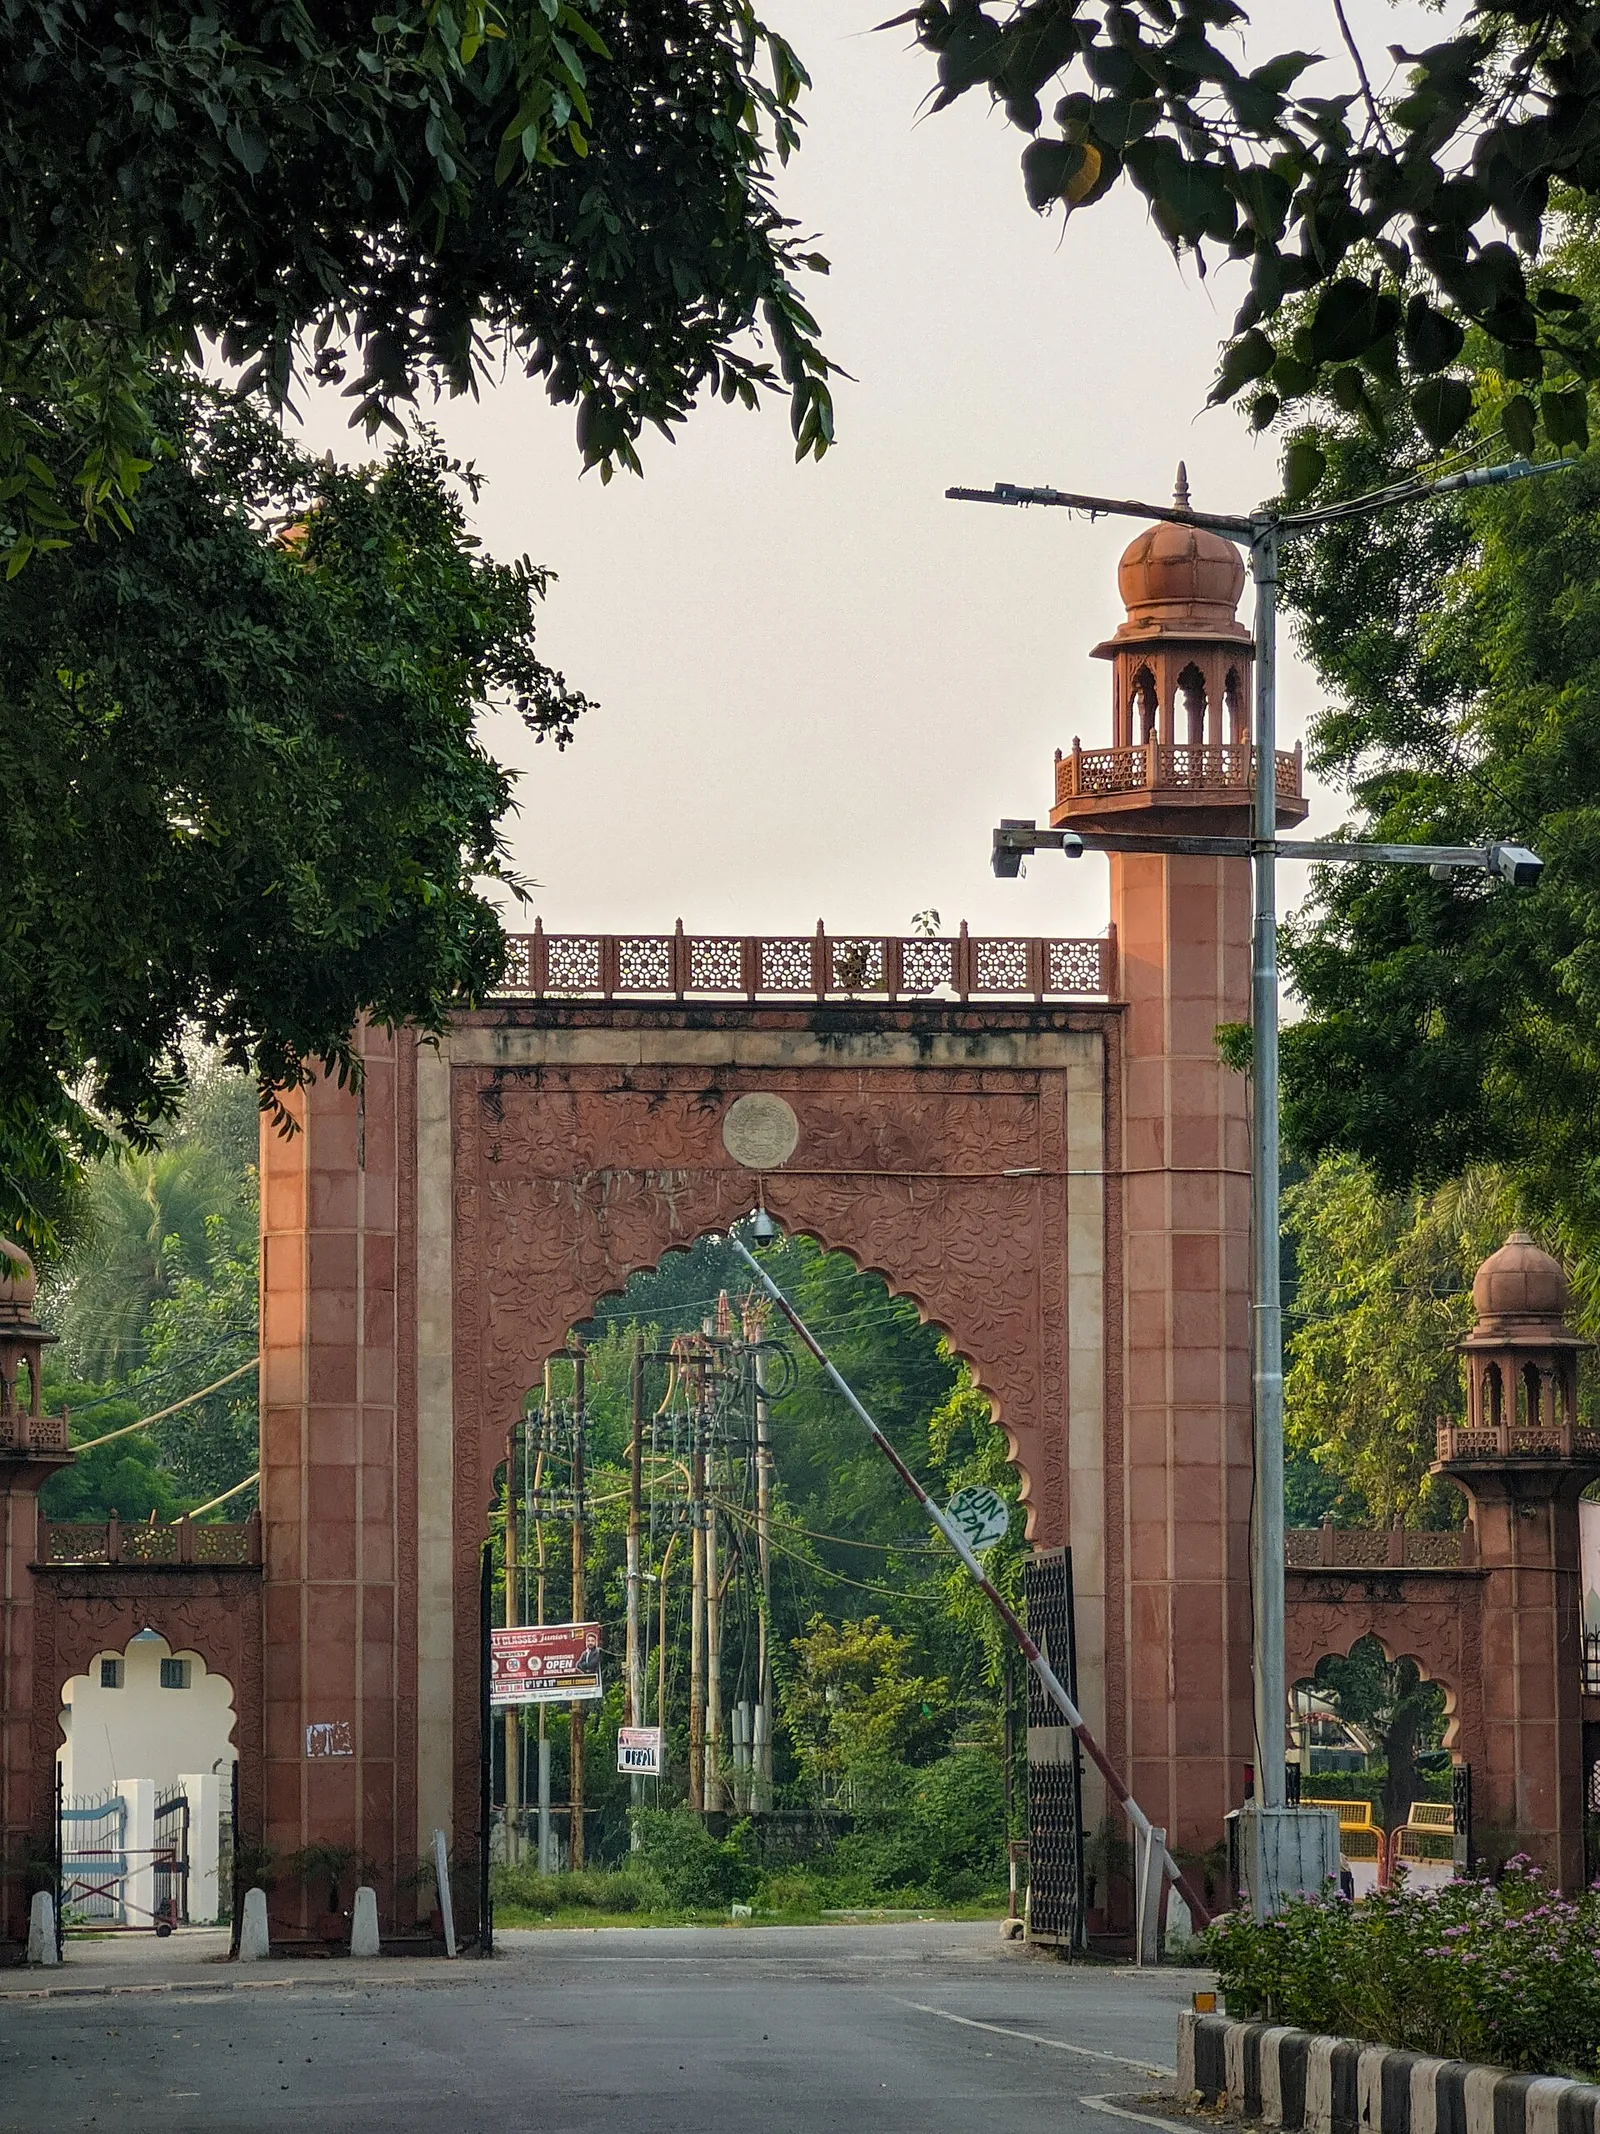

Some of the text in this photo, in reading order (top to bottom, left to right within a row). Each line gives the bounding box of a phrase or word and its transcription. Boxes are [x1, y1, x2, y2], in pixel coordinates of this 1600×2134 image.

[502, 1634, 537, 1646] CLASSES
[539, 1633, 568, 1643] Junior
[543, 1653, 575, 1661] ADMISSIONS
[546, 1660, 573, 1670] OPEN
